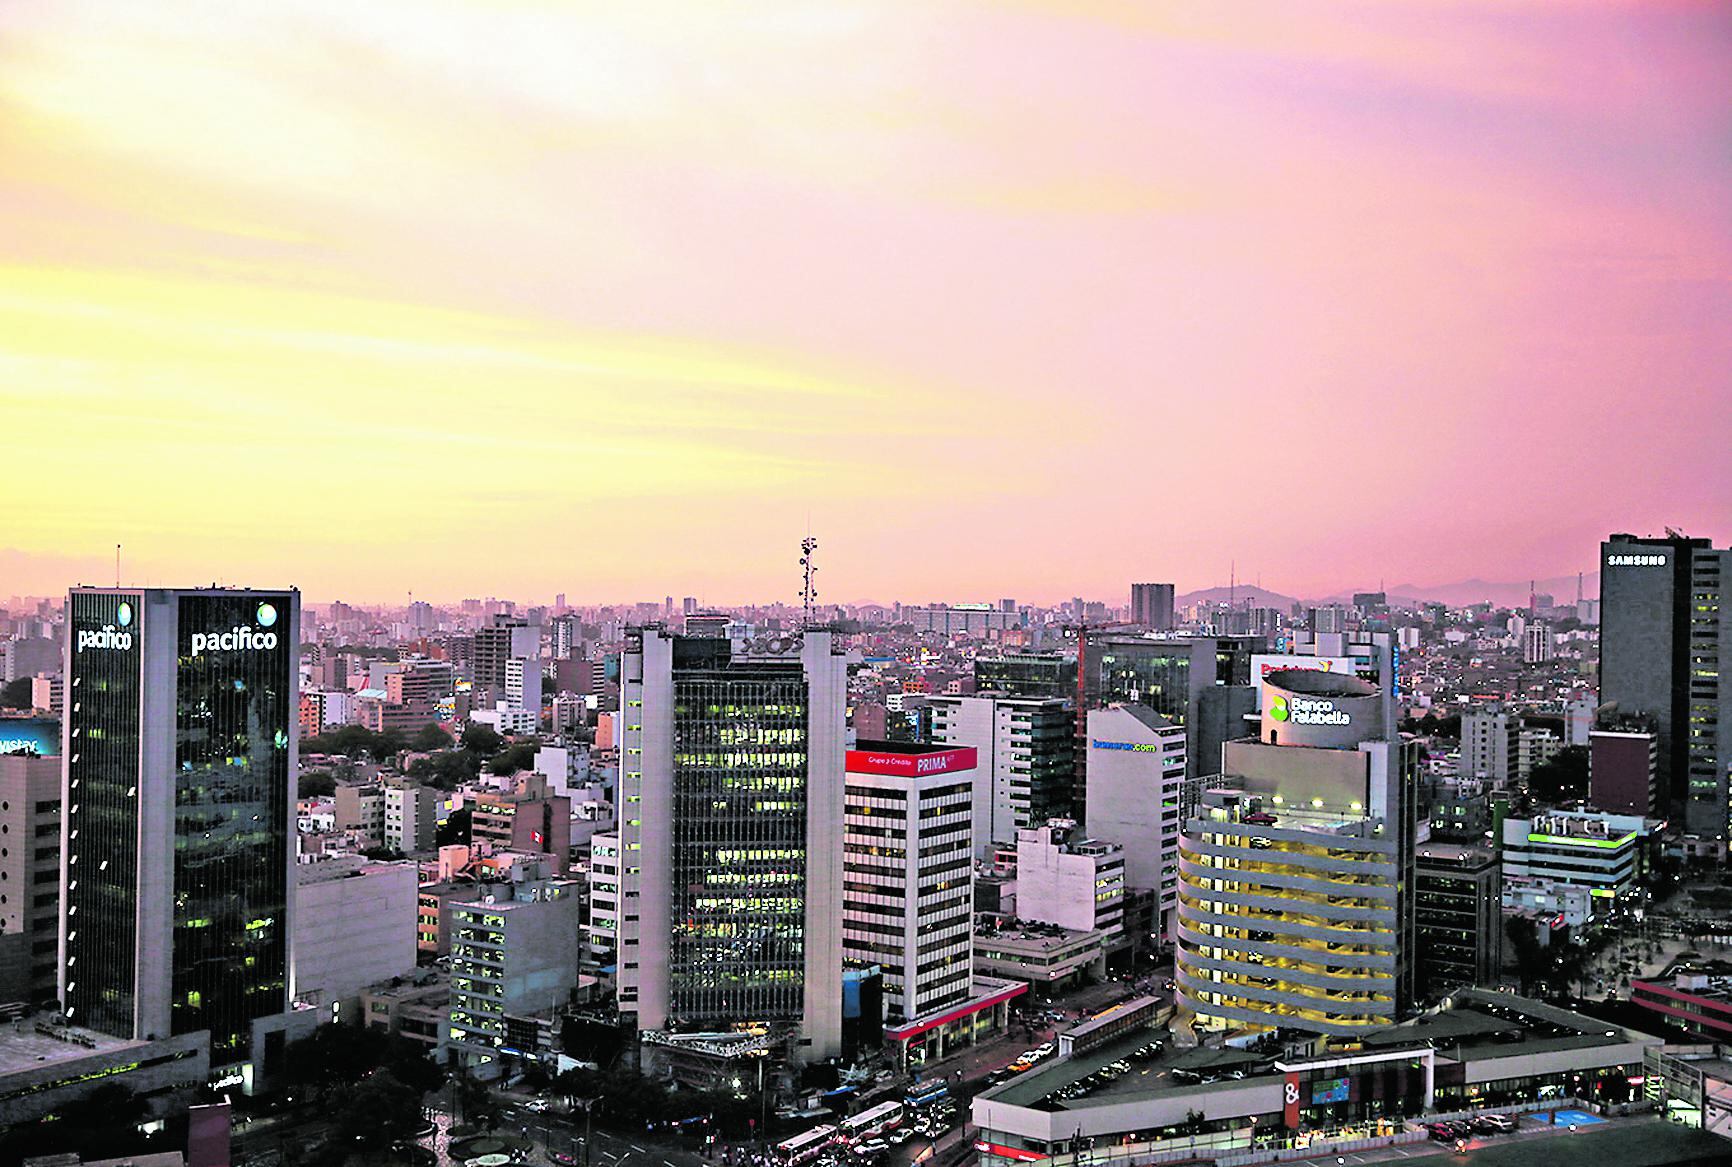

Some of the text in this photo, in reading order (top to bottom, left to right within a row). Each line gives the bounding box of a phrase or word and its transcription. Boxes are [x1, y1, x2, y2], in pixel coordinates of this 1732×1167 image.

[1608, 555, 1666, 566] SAMSUNG
[1291, 698, 1334, 712] Banco
[1291, 711, 1351, 725] Falabella
[917, 756, 947, 772] PRIMA
